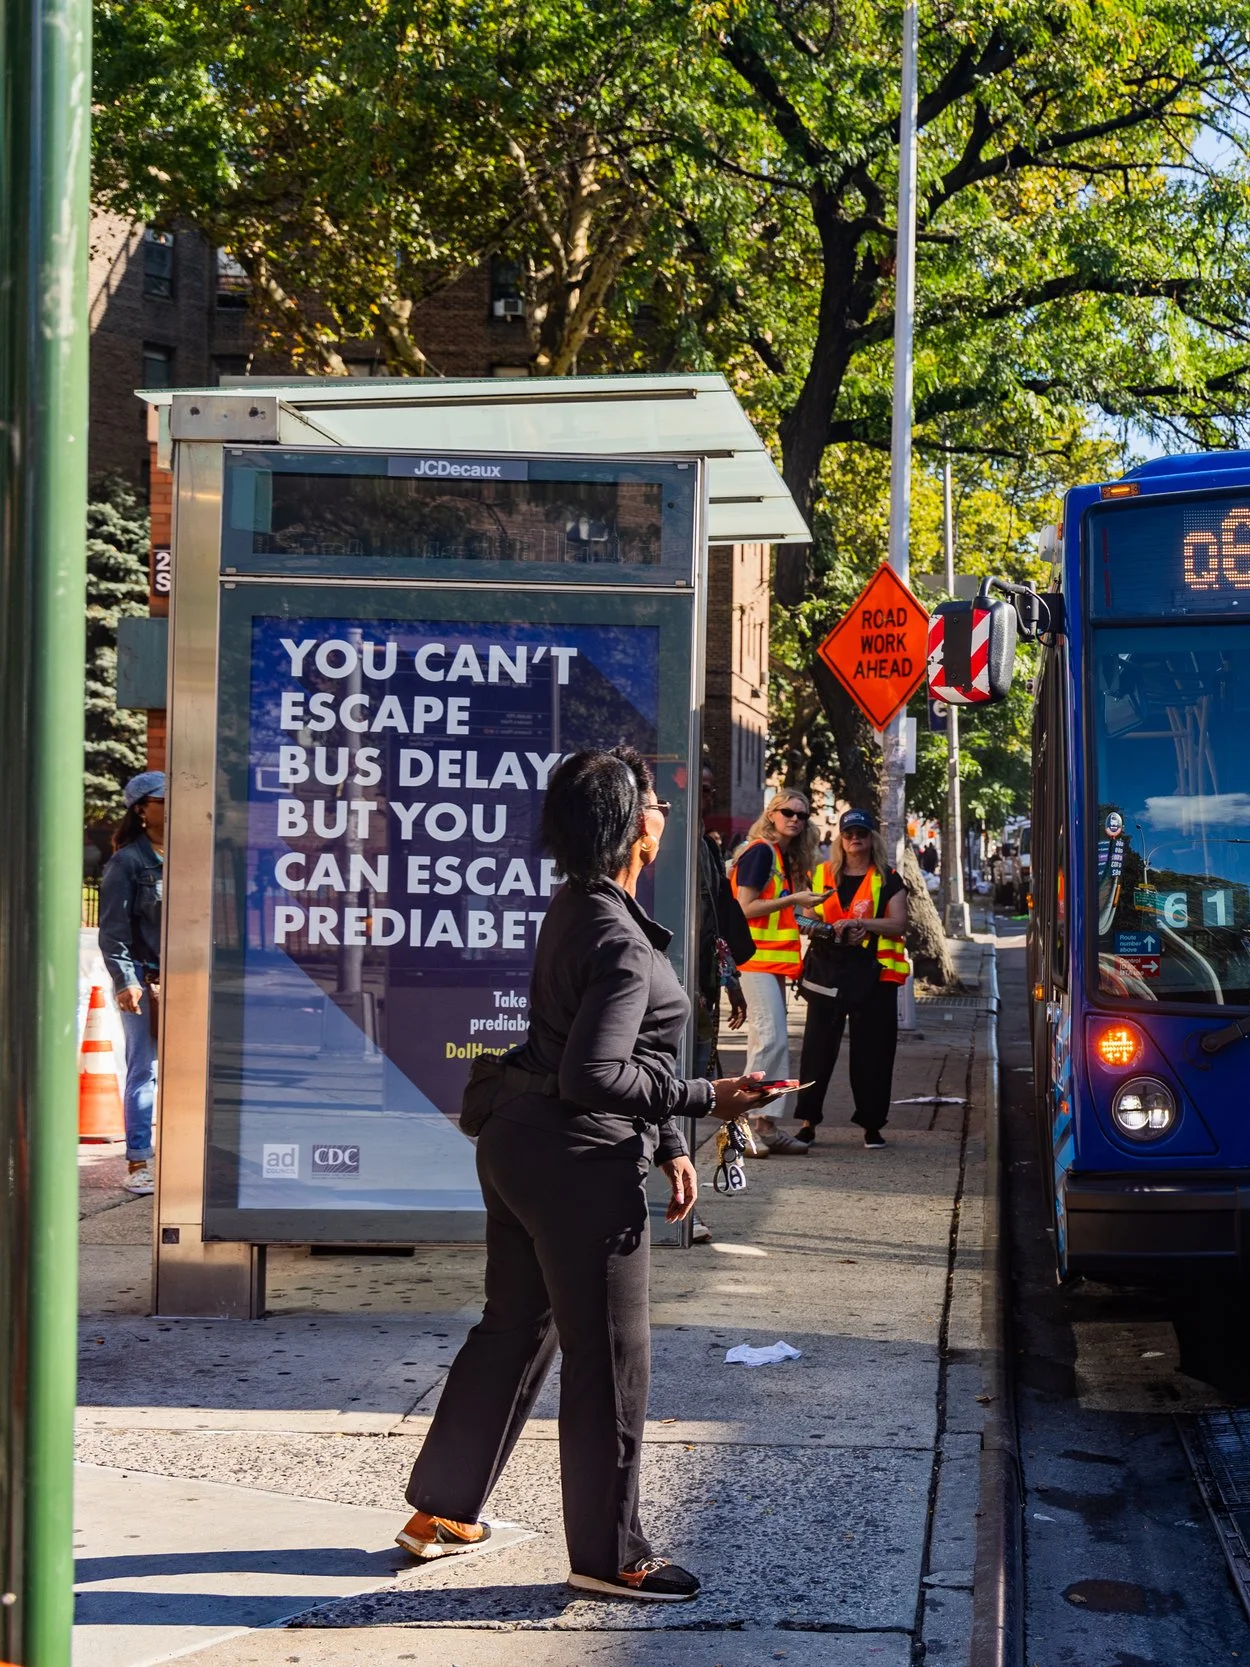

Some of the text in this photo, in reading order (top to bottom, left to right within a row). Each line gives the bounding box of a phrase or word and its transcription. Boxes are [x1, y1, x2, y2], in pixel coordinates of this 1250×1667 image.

[414, 460, 501, 477] JCDecaux
[861, 607, 908, 630] ROAD
[861, 632, 907, 655] WORK
[280, 638, 578, 685] YOU CAN'T
[853, 658, 913, 680] AHEAD
[280, 691, 471, 734] ESCAPE
[278, 745, 575, 790] BUS DELAY
[277, 798, 507, 843] BUT YOU
[274, 852, 568, 897] CAN ESCAP
[273, 905, 547, 949] PREDIABET
[493, 990, 527, 1008] Take
[266, 1147, 297, 1168] ad
[313, 1148, 358, 1166] CDC
